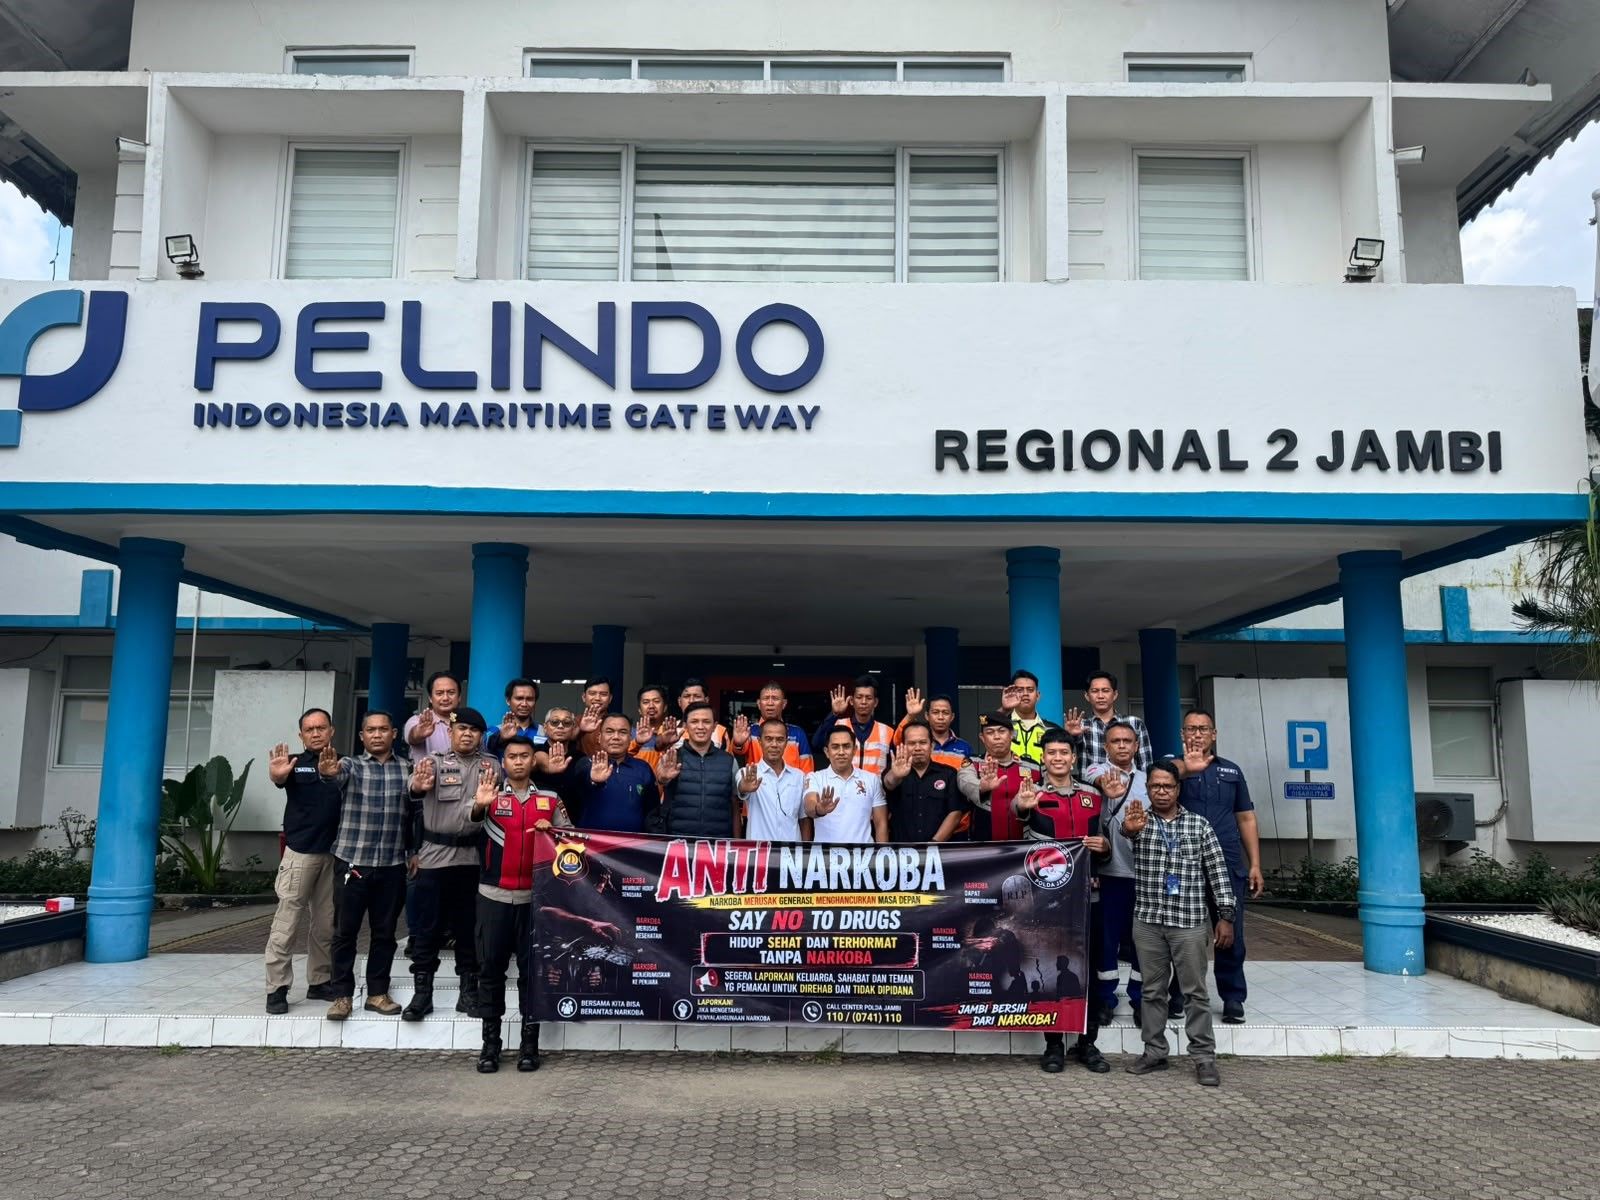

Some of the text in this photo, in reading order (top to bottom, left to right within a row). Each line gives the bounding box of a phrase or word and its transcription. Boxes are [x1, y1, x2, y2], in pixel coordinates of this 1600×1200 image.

[194, 299, 825, 393] PELINDO
[194, 401, 822, 431] INDONESIA MARITIME GATEWAY
[935, 428, 1502, 473] REGIONAL 2 JAMBI
[1296, 727, 1320, 762] P
[655, 839, 945, 902] ANTI NARKOBA
[709, 897, 743, 907] NARKOBA
[743, 897, 777, 906] MERUSAK
[815, 895, 876, 905] MENGHANCURKAN
[878, 895, 897, 905] MASA
[898, 895, 921, 904] DEPAN
[728, 909, 902, 931] SAY NO TO DRUGS
[729, 936, 898, 949] HIDUP SEHAT DAN TERHORMAT
[760, 950, 873, 964] TANPA NARKOBA
[724, 971, 914, 984] SEGERA LAPORKAN KELUARGA, SAHABAT DAN TEMAN
[724, 982, 914, 995] YG PEMAKAI UNTUK DIREHAB DAN TIDAK DIPIDANA
[580, 999, 611, 1007] BERSAMA
[626, 1000, 641, 1008] BISA
[826, 1003, 841, 1011] CALL
[841, 1003, 864, 1011] CENTER
[957, 1003, 1028, 1015] JAMBI BERSIH
[580, 1008, 614, 1016] BERANTAS
[826, 1012, 844, 1022] 110
[852, 1012, 883, 1024] (0741)
[885, 1013, 902, 1023] 110
[972, 1012, 1058, 1026] DARI NARKOBA!
